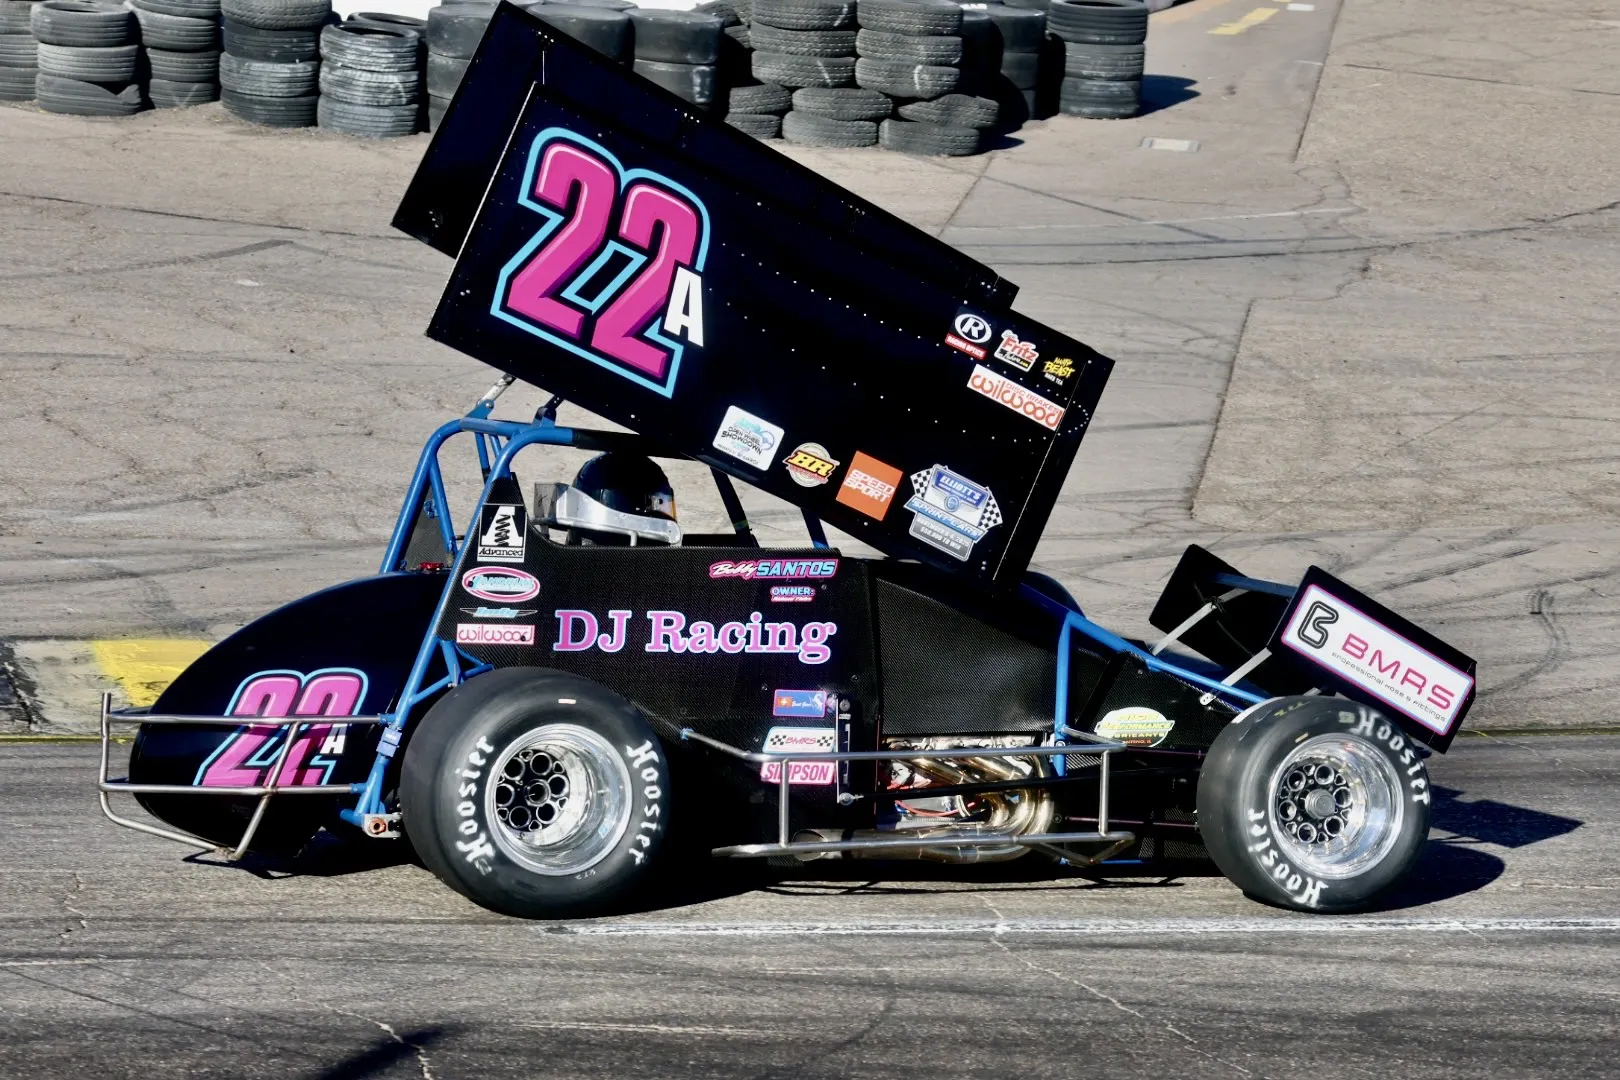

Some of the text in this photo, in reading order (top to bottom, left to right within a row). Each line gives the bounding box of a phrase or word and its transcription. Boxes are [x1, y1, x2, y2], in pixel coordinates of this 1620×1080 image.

[490, 127, 711, 399] 22
[1001, 337, 1037, 361] Fritz
[1043, 361, 1075, 378] BEAST
[970, 374, 1064, 428] wilwood
[720, 430, 763, 455] SHOWDOWN
[843, 477, 891, 503] SPORT
[851, 468, 896, 494] SPEED
[478, 547, 524, 557] Advanced
[756, 561, 836, 577] SANTOS
[771, 587, 814, 596] OWNER:
[553, 610, 837, 664] DJ Racing
[1340, 632, 1456, 711] BMRS
[192, 667, 368, 786] 22
[785, 737, 817, 745] BMRS
[1349, 705, 1430, 805] Hoosier
[765, 763, 830, 781] SIPSON
[455, 735, 495, 863] Hoosier
[625, 740, 663, 865] Hoosier
[1248, 808, 1329, 908] Hoosier
